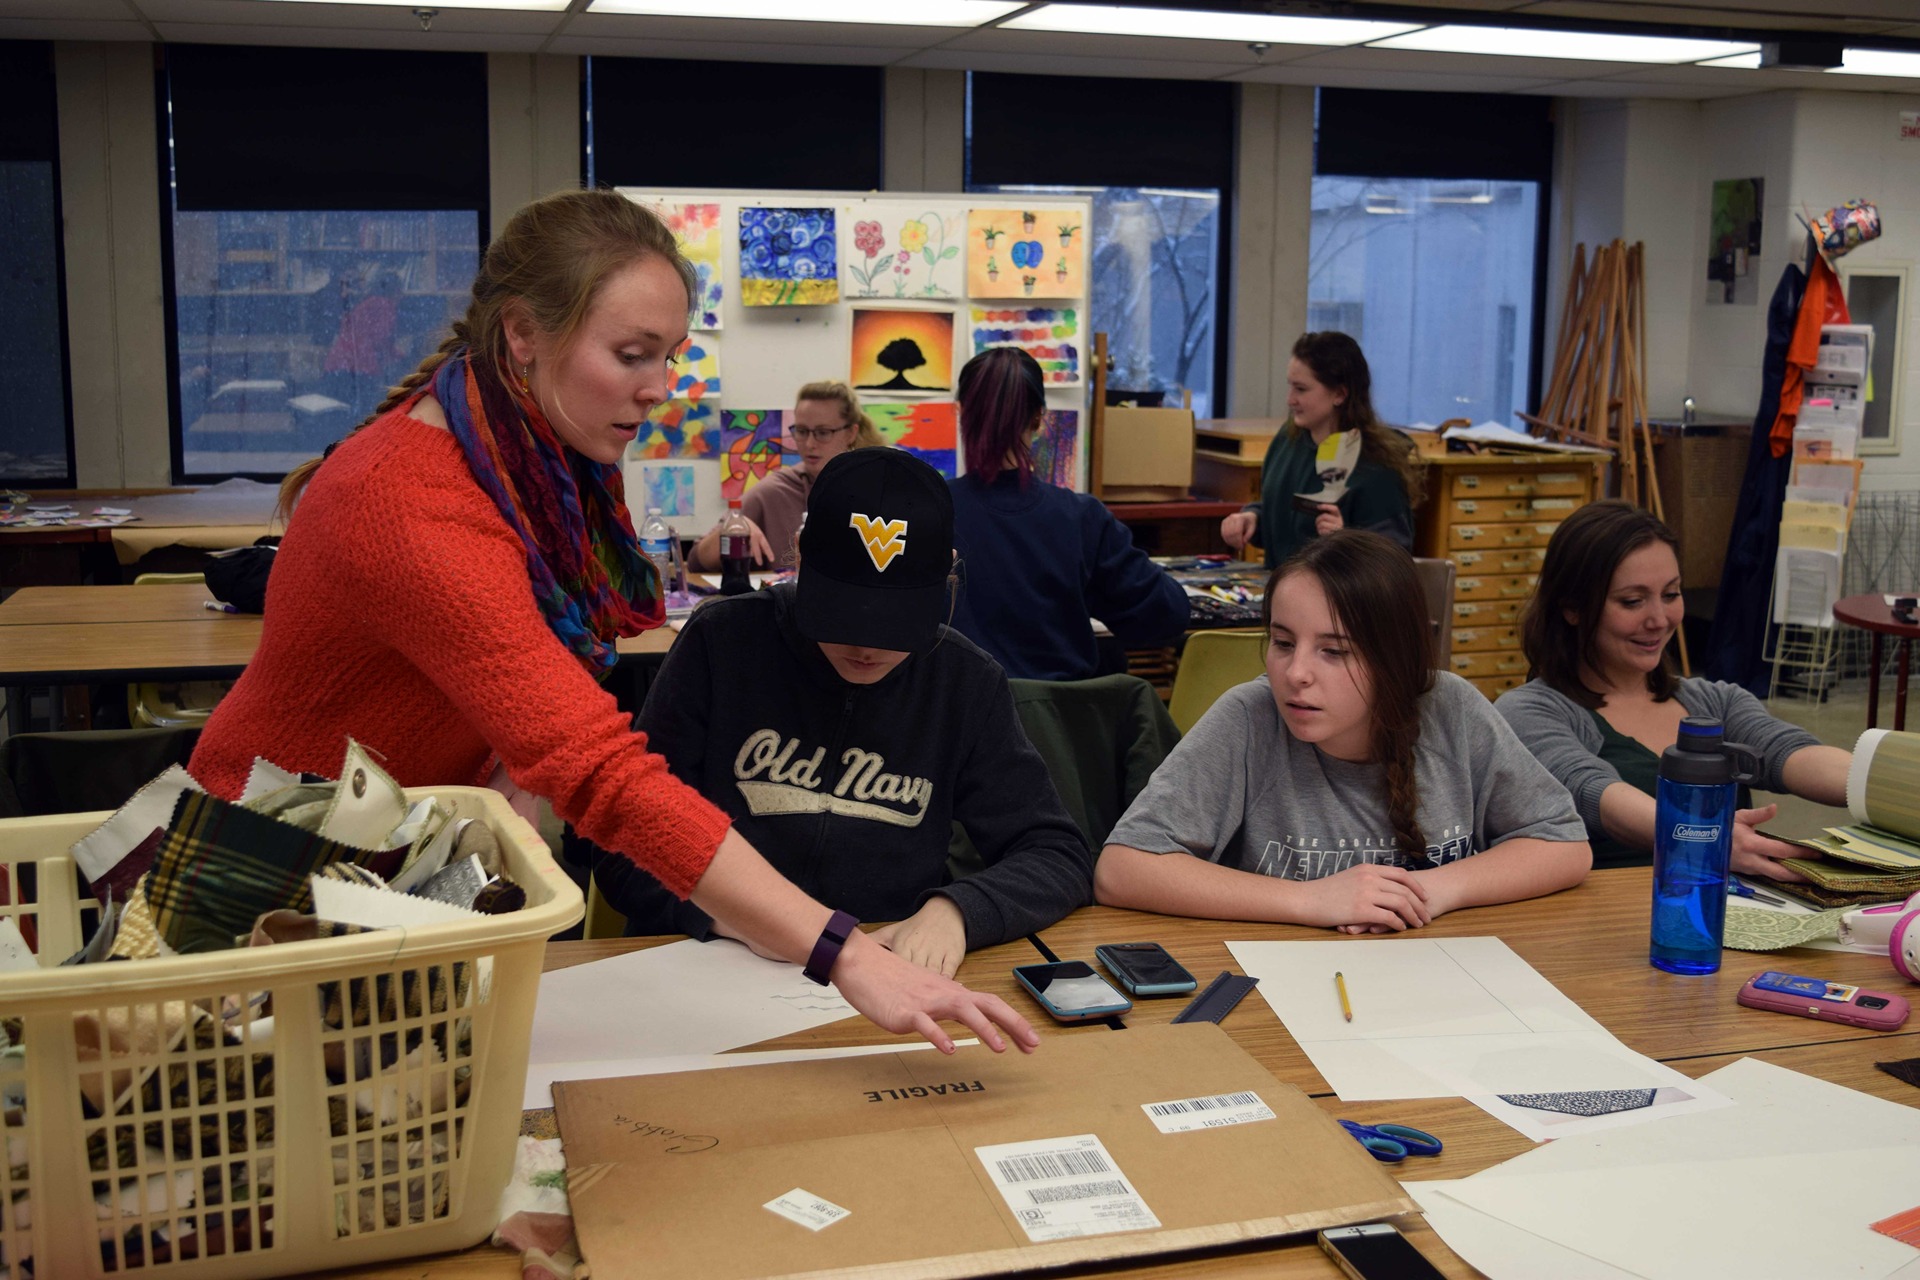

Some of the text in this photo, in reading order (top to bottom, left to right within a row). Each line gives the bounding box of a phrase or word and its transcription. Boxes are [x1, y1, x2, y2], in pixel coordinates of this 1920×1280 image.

[734, 728, 934, 809] Old Navy
[1286, 825, 1461, 848] THE COLLE OF
[1676, 826, 1711, 837] Coleman
[1256, 840, 1354, 881] NEW
[863, 1080, 986, 1103] FRAGILE
[1202, 1117, 1237, 1127] 51591
